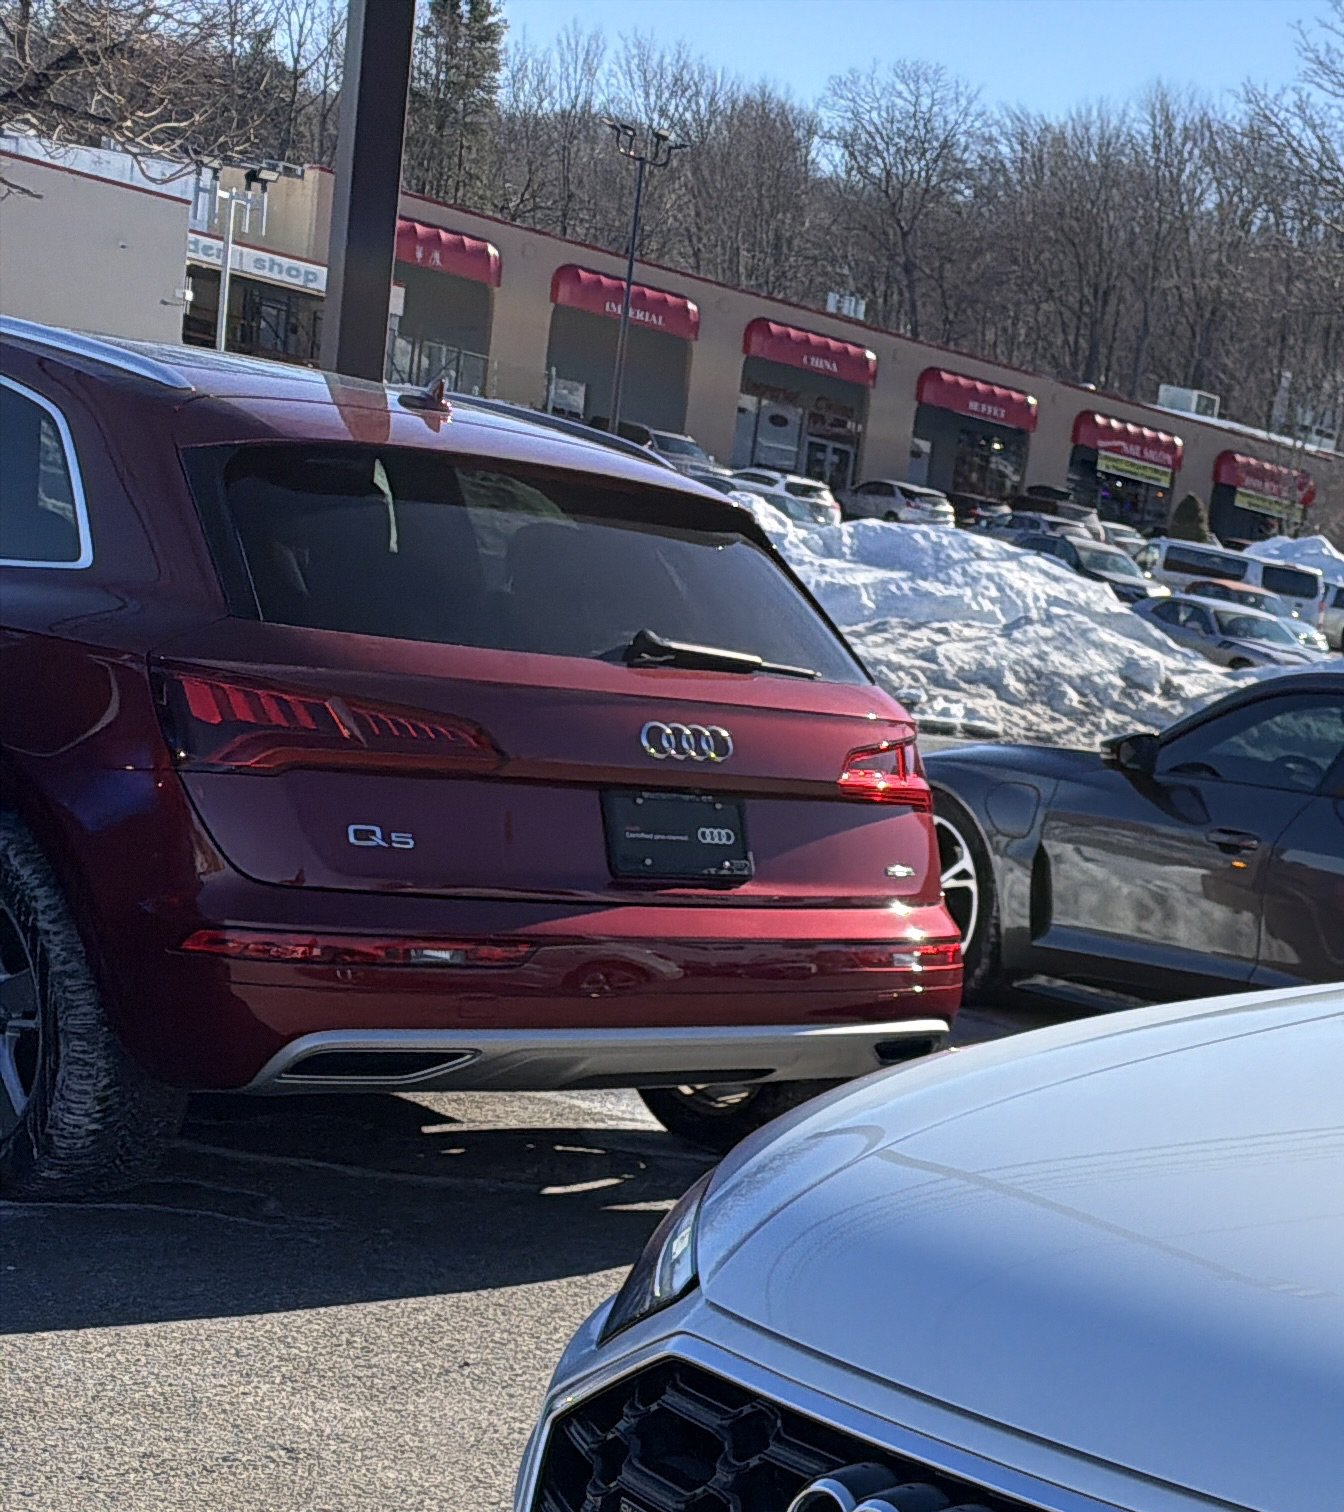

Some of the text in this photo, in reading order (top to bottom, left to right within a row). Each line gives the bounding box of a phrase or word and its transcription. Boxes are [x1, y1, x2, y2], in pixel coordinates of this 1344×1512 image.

[253, 257, 319, 286] shop
[802, 355, 838, 373] CHINA
[347, 824, 415, 849] Q5
